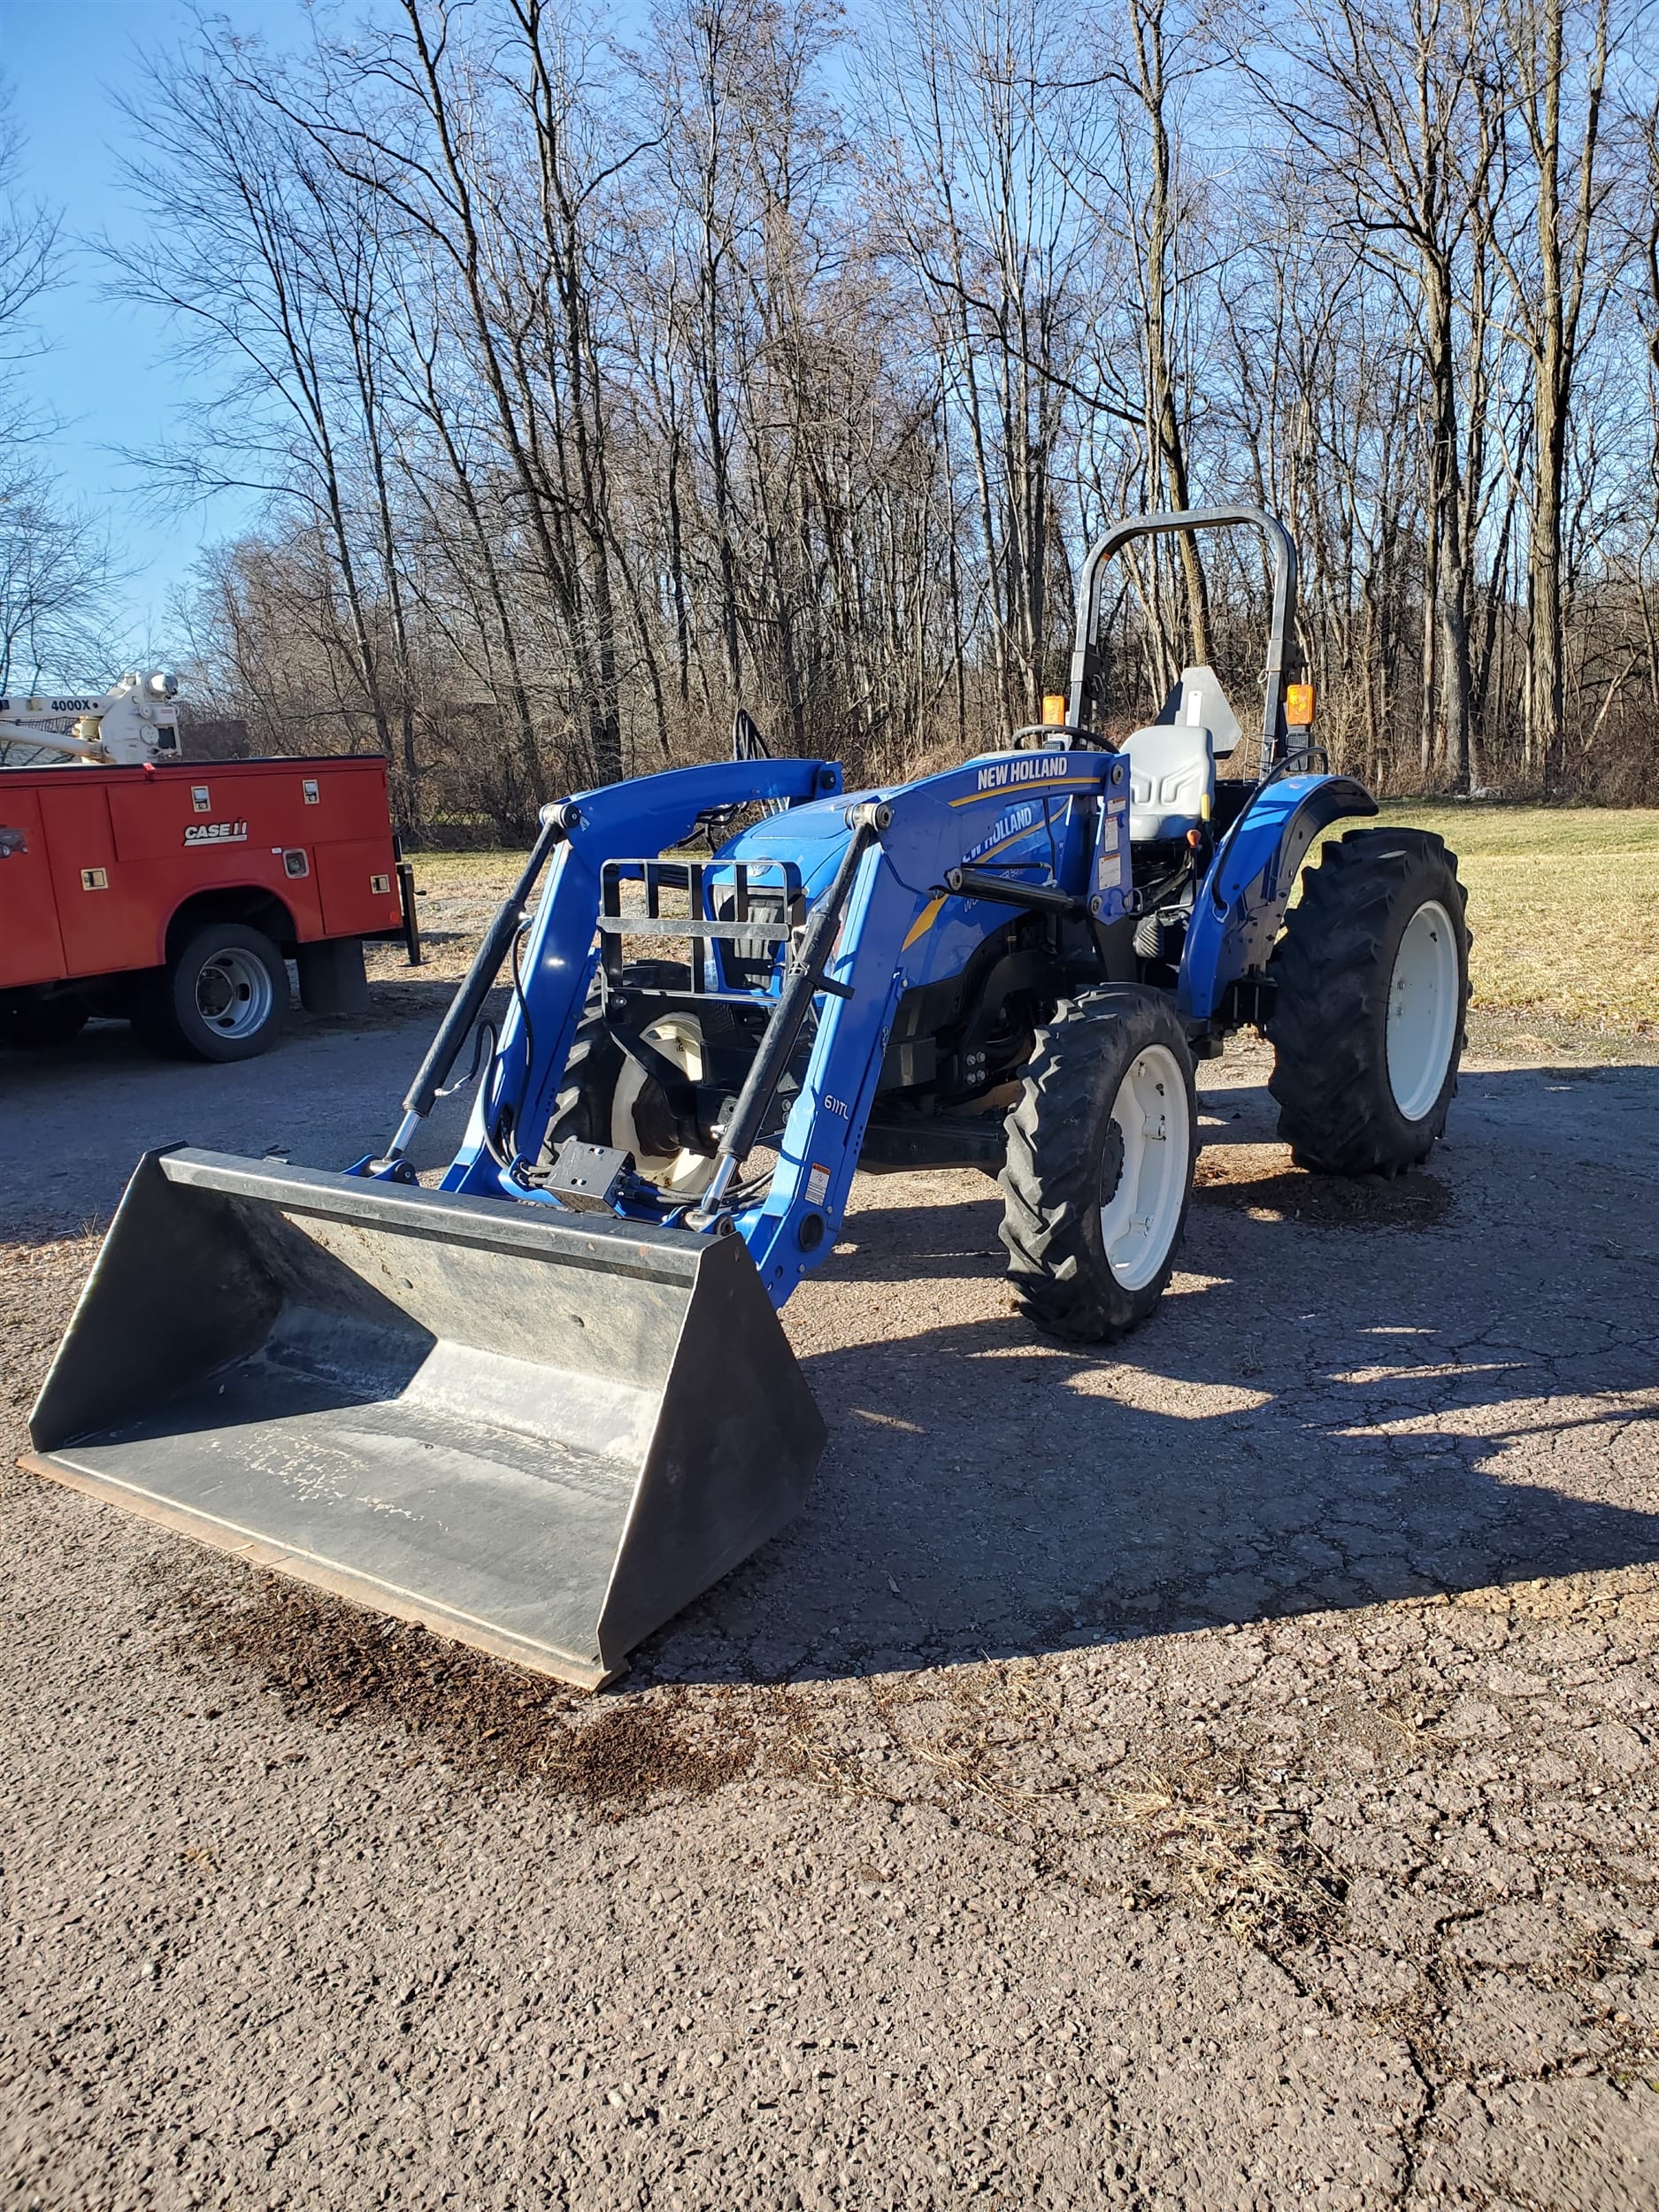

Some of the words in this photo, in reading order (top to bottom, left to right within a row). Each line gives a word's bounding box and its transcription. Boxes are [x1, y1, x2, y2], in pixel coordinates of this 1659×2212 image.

[50, 700, 90, 711] 4000X
[978, 764, 1009, 790] NEW
[1010, 757, 1067, 782] HOLLAND
[185, 824, 230, 839] CASE
[825, 1094, 849, 1119] 611TL
